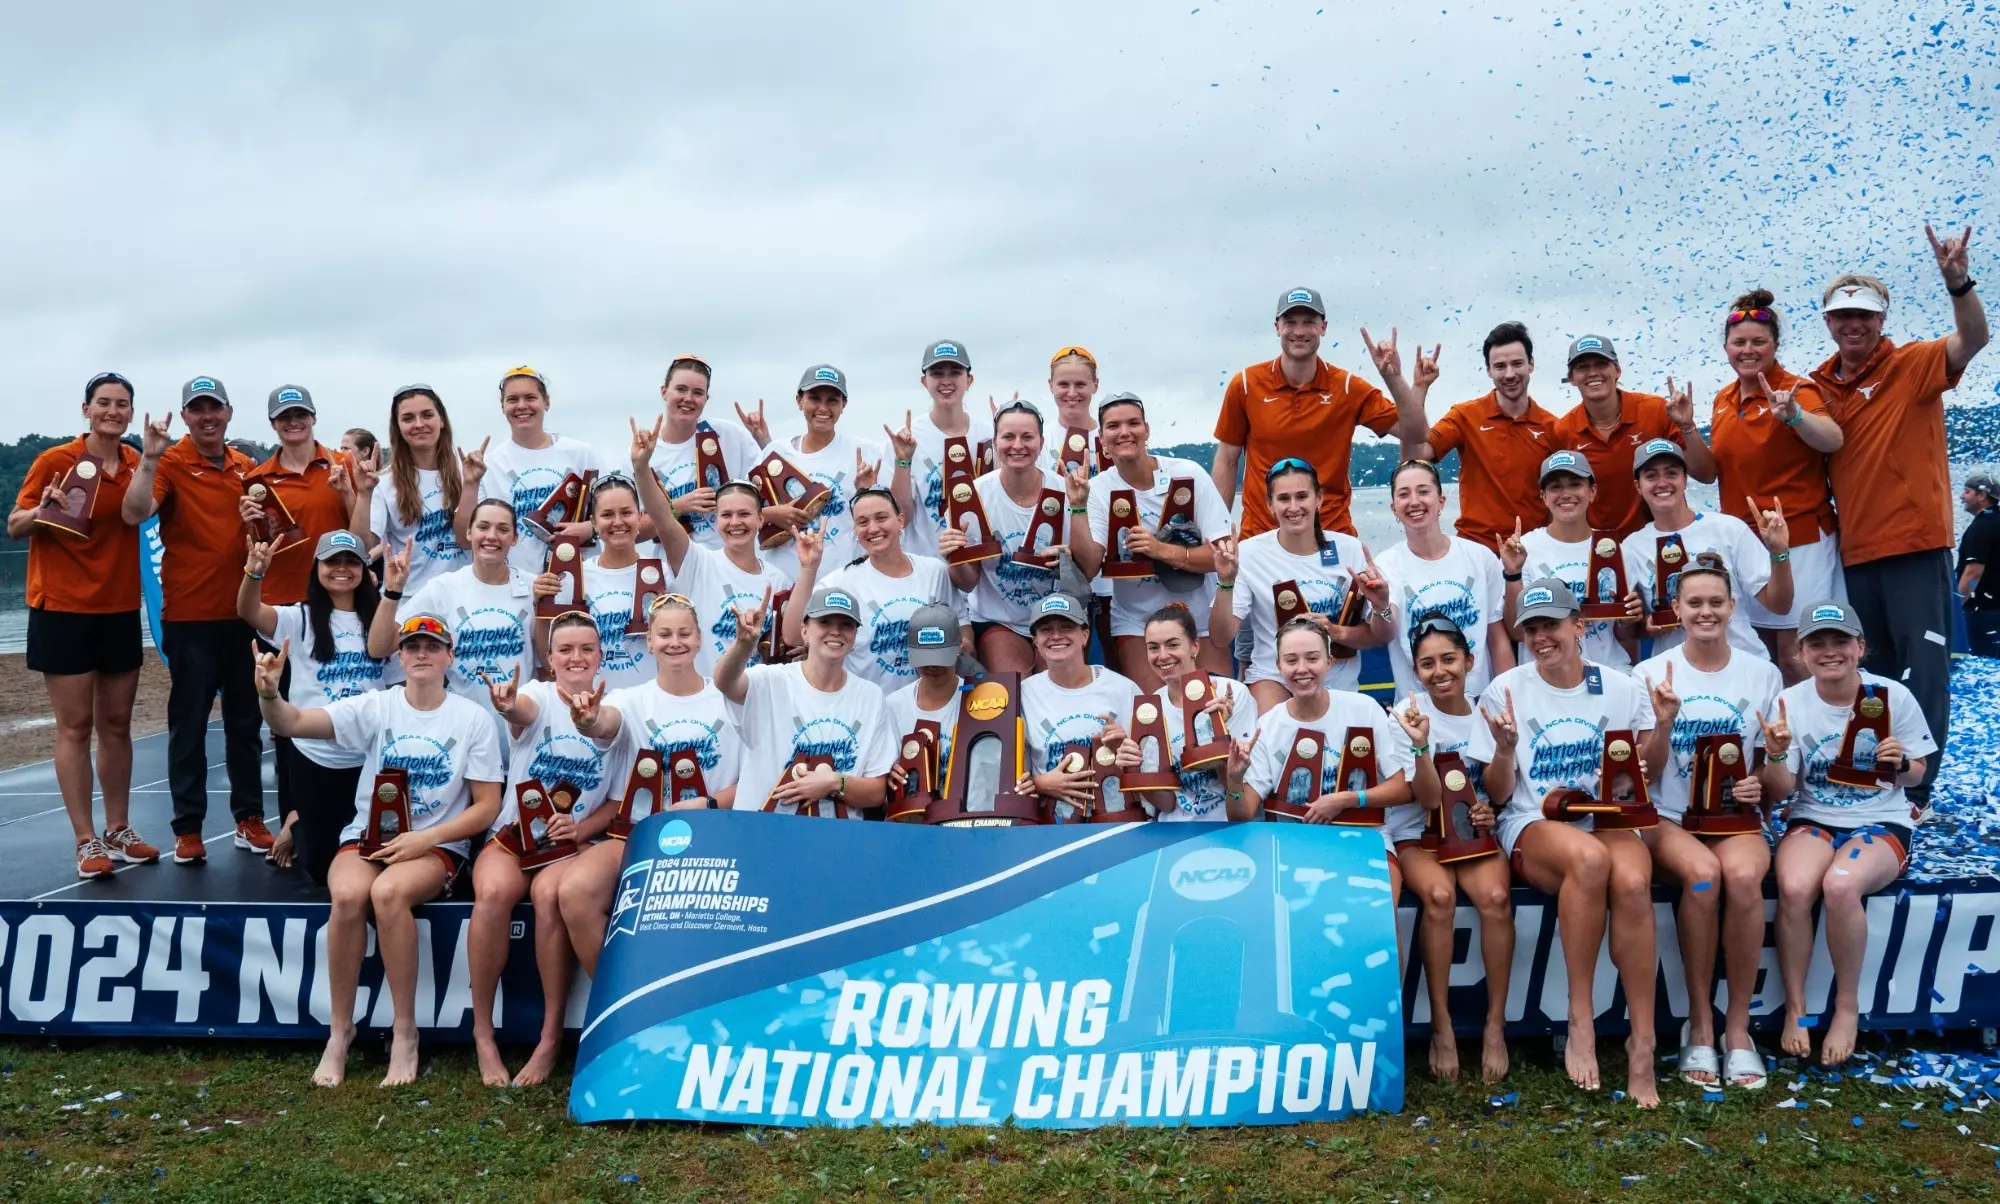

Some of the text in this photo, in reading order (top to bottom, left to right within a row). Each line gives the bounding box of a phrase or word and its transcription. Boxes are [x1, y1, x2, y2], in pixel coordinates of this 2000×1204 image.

[514, 484, 556, 501] NATION
[421, 546, 466, 561] ROWIN
[996, 563, 1053, 582] CHAMPION
[472, 607, 495, 616] NCAA
[458, 627, 520, 643] NATIONAL
[454, 641, 526, 660] CHAMPIONS
[316, 664, 384, 682] CHAMPIONS
[969, 696, 1009, 713] NCAA
[1683, 695, 1710, 704] NCAA
[662, 719, 687, 729] NCAA
[807, 717, 831, 728] NCAA
[1057, 714, 1081, 727] NCAA
[1545, 717, 1573, 729] NCAA
[1533, 738, 1602, 763] NATIONAL
[383, 754, 446, 771] NATIONAL
[533, 753, 601, 773] NATIONAL
[1529, 755, 1601, 781] CHAMPION
[660, 835, 692, 848] NCAA
[656, 857, 737, 869] 2024 DIVISION I
[650, 869, 740, 893] ROWING
[1175, 866, 1251, 888] NCAA
[645, 893, 769, 913] CHAMPIONSHIPS
[669, 912, 681, 920] OH
[684, 911, 715, 921] Marietta
[715, 912, 742, 922] College,
[639, 921, 768, 934] Visit Cincy and Discover Clermont, Hosts
[0, 914, 210, 1024] 024
[829, 978, 1113, 1049] ROWING
[676, 1041, 1377, 1120] NATIONAL CHAMPION
